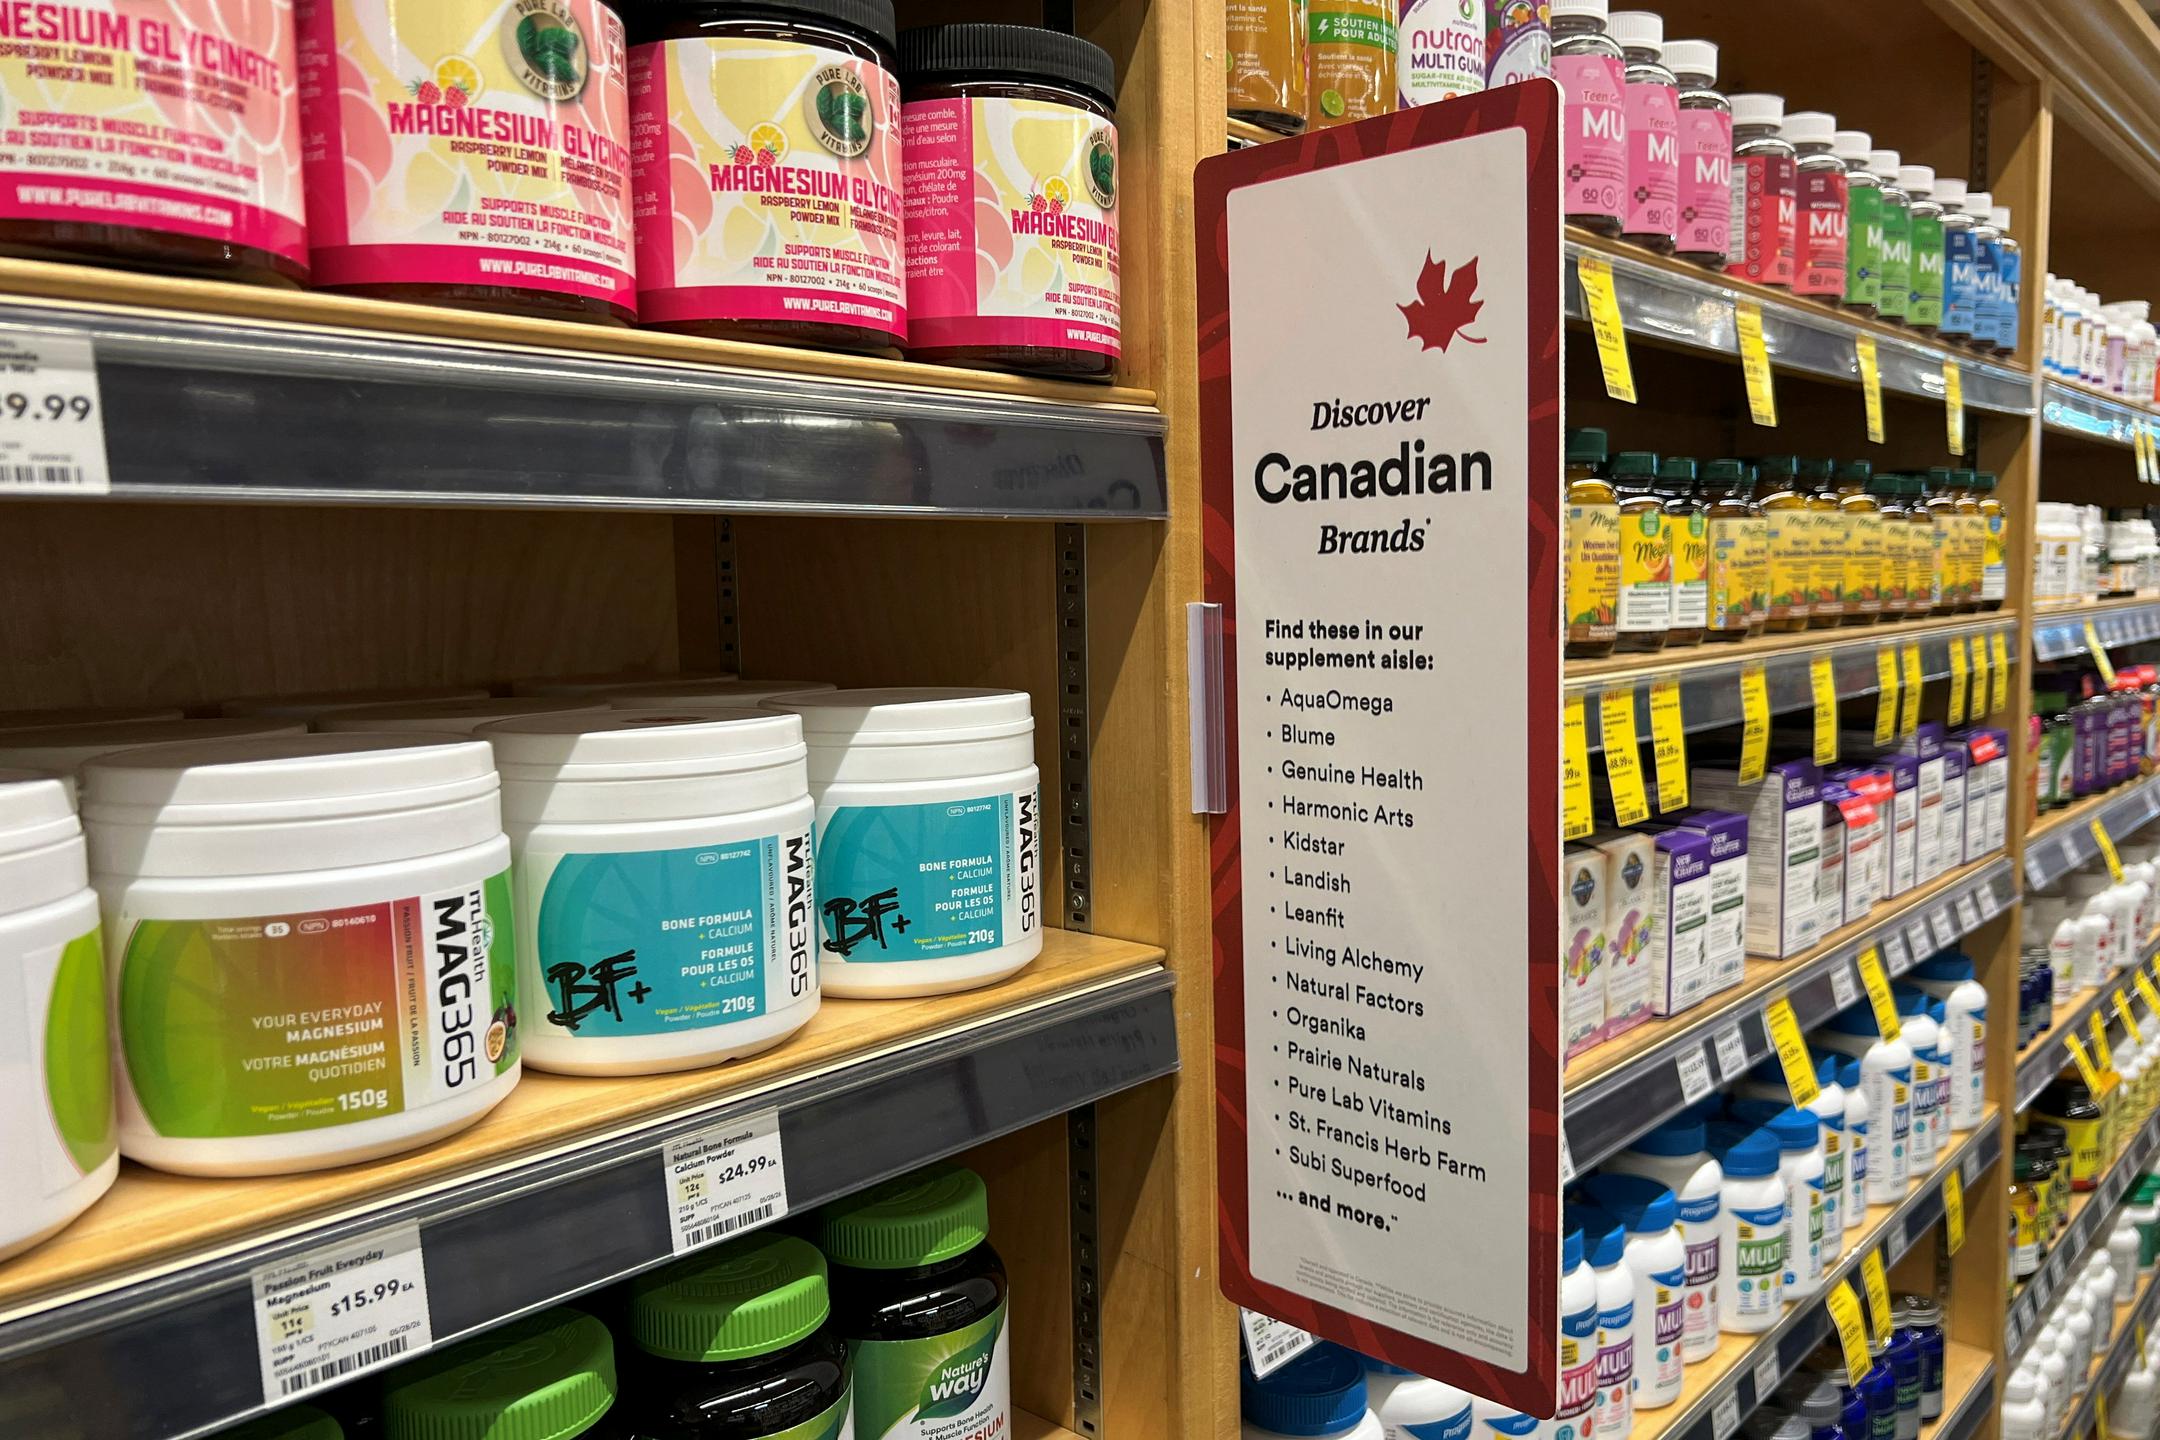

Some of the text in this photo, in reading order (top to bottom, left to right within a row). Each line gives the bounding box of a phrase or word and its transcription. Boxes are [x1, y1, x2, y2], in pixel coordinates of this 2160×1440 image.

[1334, 18, 1378, 31] SOUTIEN
[1334, 29, 1364, 39] POUR
[1412, 53, 1455, 69] MULTI
[816, 68, 841, 86] PURE
[1584, 91, 1608, 101] Teen
[388, 101, 558, 151] MAGNESIUM
[930, 122, 958, 132] mesure
[936, 133, 956, 143] selon
[451, 141, 547, 163] RASPBERRY LEMON
[918, 157, 959, 169] musculaire.
[488, 160, 529, 175] POWDER
[937, 168, 966, 181] 200mg
[709, 164, 848, 201] MAGNESIUM
[947, 182, 957, 191] de
[481, 197, 538, 215] SUPPORTS
[761, 195, 839, 212] RASPBERRY LEMON
[932, 194, 958, 204] Poudre
[1583, 189, 1598, 200] 60
[790, 211, 840, 226] POWDER MIX
[1011, 209, 1106, 246] MAGNESIUM
[785, 243, 862, 263] SUPPORTS MUSCLE
[929, 242, 960, 252] colorant
[1052, 239, 1086, 252] RASPBERRY
[753, 257, 874, 281] AIDE AU SOUTIEN LA FONCTION
[929, 266, 944, 276] être
[1072, 254, 1095, 266] POWDER
[767, 274, 825, 286] NPN 80127002
[1068, 282, 1097, 296] SUPPORTS
[0, 392, 91, 421] 9.99
[1311, 398, 1430, 430] Discover
[1255, 439, 1492, 504] Canadian
[1265, 619, 1423, 640] Find these in our
[1265, 648, 1433, 671] supplement aisle:
[1280, 688, 1393, 716] AquaOmega
[1282, 724, 1335, 746] Blume
[1282, 760, 1423, 791] Genuine Health
[1283, 795, 1414, 828] Harmonic Arts
[1284, 830, 1345, 856] Kidstar
[919, 855, 993, 872] BONE FORMULA
[957, 867, 993, 881] CALCIUM
[1018, 794, 1035, 932] MAG365
[951, 883, 993, 898] FORMULE
[1284, 865, 1350, 893] Landish
[935, 895, 993, 912] POUR LES OS
[958, 908, 994, 921] CALCIUM
[1285, 900, 1344, 928] Leanfit
[661, 909, 753, 931] BONE FORMULA
[786, 836, 808, 997] MAG365
[708, 923, 753, 940] CALCIUM
[968, 929, 995, 944] 210g
[701, 942, 753, 961] FORMULE
[1286, 936, 1423, 984] Living Alchemy
[681, 957, 754, 977] POUR LES OS
[710, 970, 755, 987] CALCIUM
[434, 895, 476, 1088] MAG365
[1287, 971, 1424, 1017] Natural Factors
[252, 1001, 383, 1029] YOUR EVERYDAY
[722, 995, 755, 1015] 210g
[286, 1018, 384, 1044] MAGNESIUM
[407, 978, 421, 1067] FRUIT PASSION
[1287, 1007, 1366, 1040] Organika
[242, 1040, 385, 1072] VOTRE MAGNÉSIUM
[1288, 1041, 1425, 1091] Prairie Naturals
[309, 1058, 386, 1083] QUOTIDIEN
[337, 1088, 388, 1112] 150g
[1289, 1076, 1451, 1135] Pure Lab Vitamins
[673, 1146, 702, 1162] Natural
[703, 1141, 721, 1153] Bone
[723, 1131, 753, 1146] Formula
[1289, 1111, 1486, 1182] St. Francis Herb Farm
[675, 1148, 735, 1174] Calcium Powder
[719, 1156, 766, 1184] $24.99
[1289, 1146, 1426, 1202] Subi Superfood
[685, 1183, 700, 1193] 12¢
[1298, 1190, 1331, 1213] and
[1739, 1243, 1782, 1267] MULTI
[264, 1275, 307, 1294] Passion
[309, 1264, 334, 1280] Fruit
[336, 1249, 385, 1271] Everyday
[267, 1281, 331, 1308] Magnesium
[331, 1279, 415, 1317] $15.99 EA
[942, 1352, 989, 1380] Nature's
[930, 1367, 983, 1402] way
[920, 1403, 994, 1436] Supports Bone Health
[963, 1415, 990, 1432] Function
